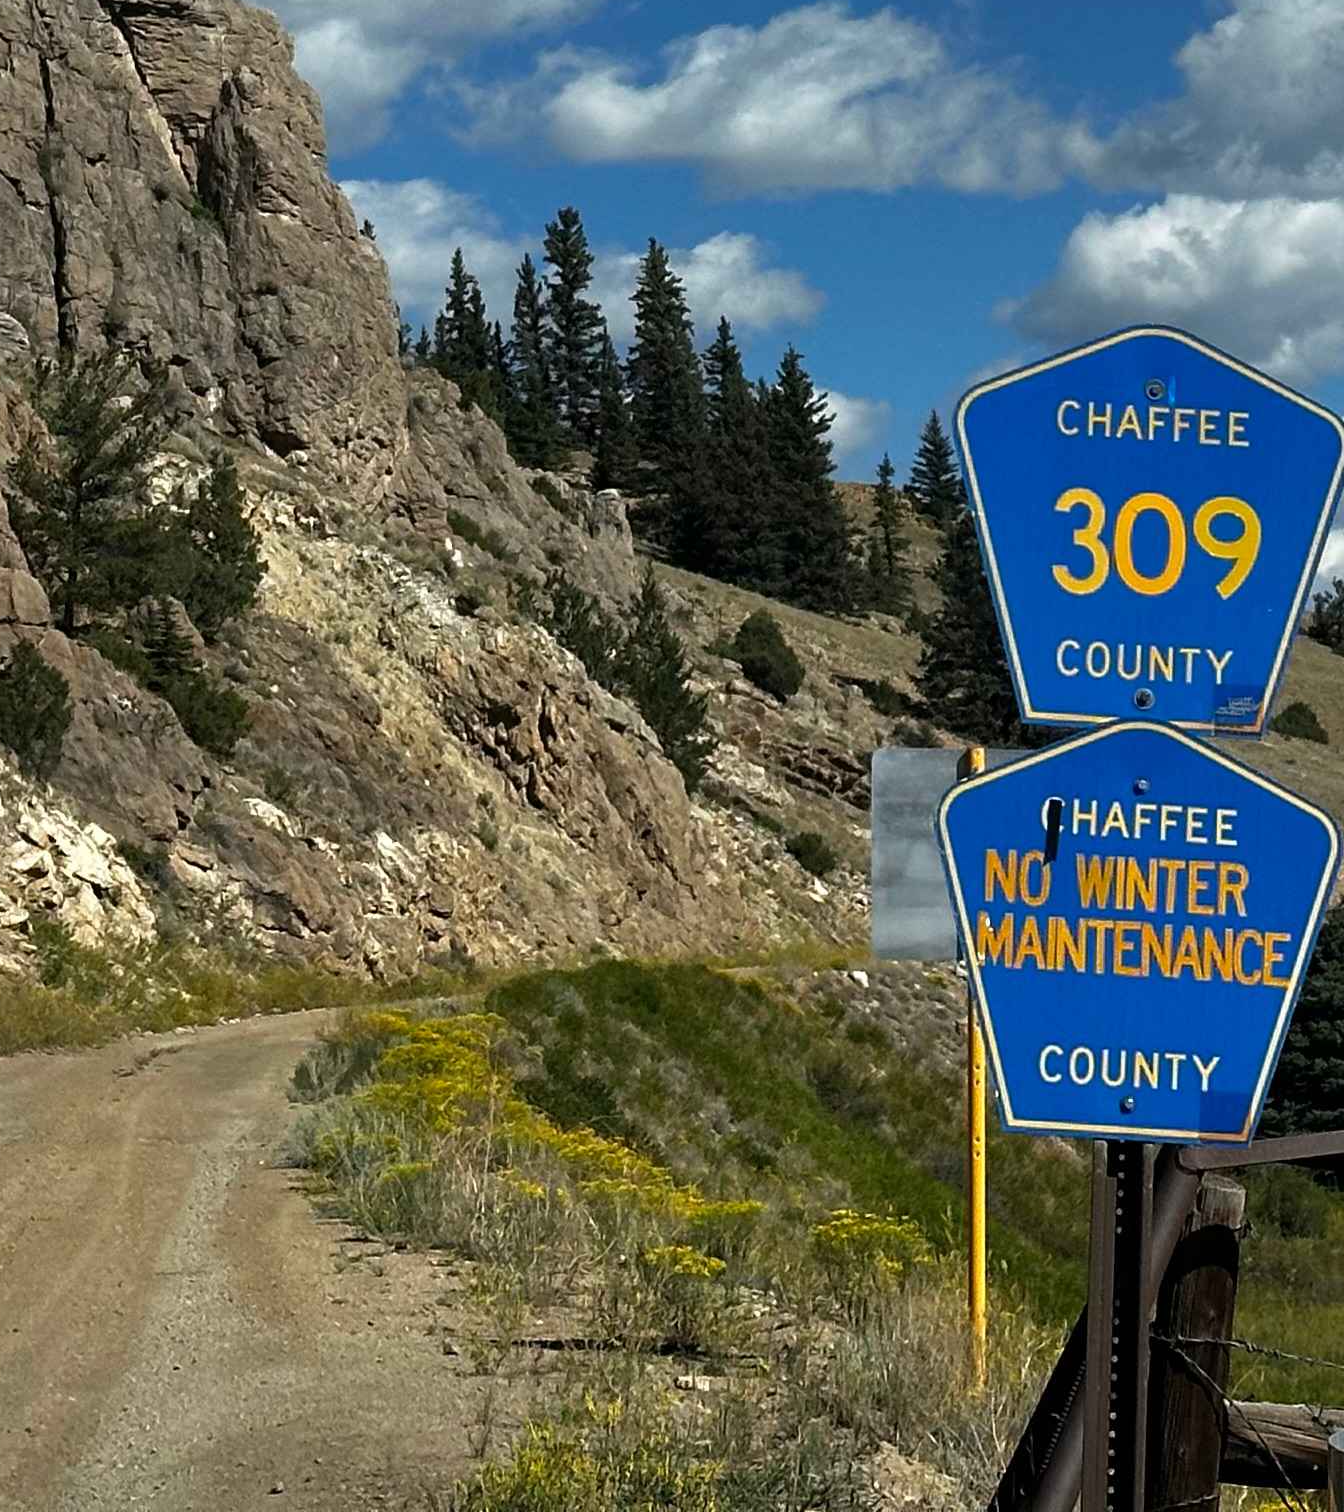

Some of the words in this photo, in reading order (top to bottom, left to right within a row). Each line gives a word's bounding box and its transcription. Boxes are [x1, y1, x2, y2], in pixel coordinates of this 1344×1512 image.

[1056, 400, 1250, 448] CHAFFEE
[1052, 488, 1261, 600] 309
[1056, 640, 1233, 685] COUNTY
[985, 849, 1050, 906] NO
[1076, 853, 1248, 917] WINTER
[976, 912, 1292, 989] MAINTENANCE
[1038, 1044, 1220, 1092] COUNTY
